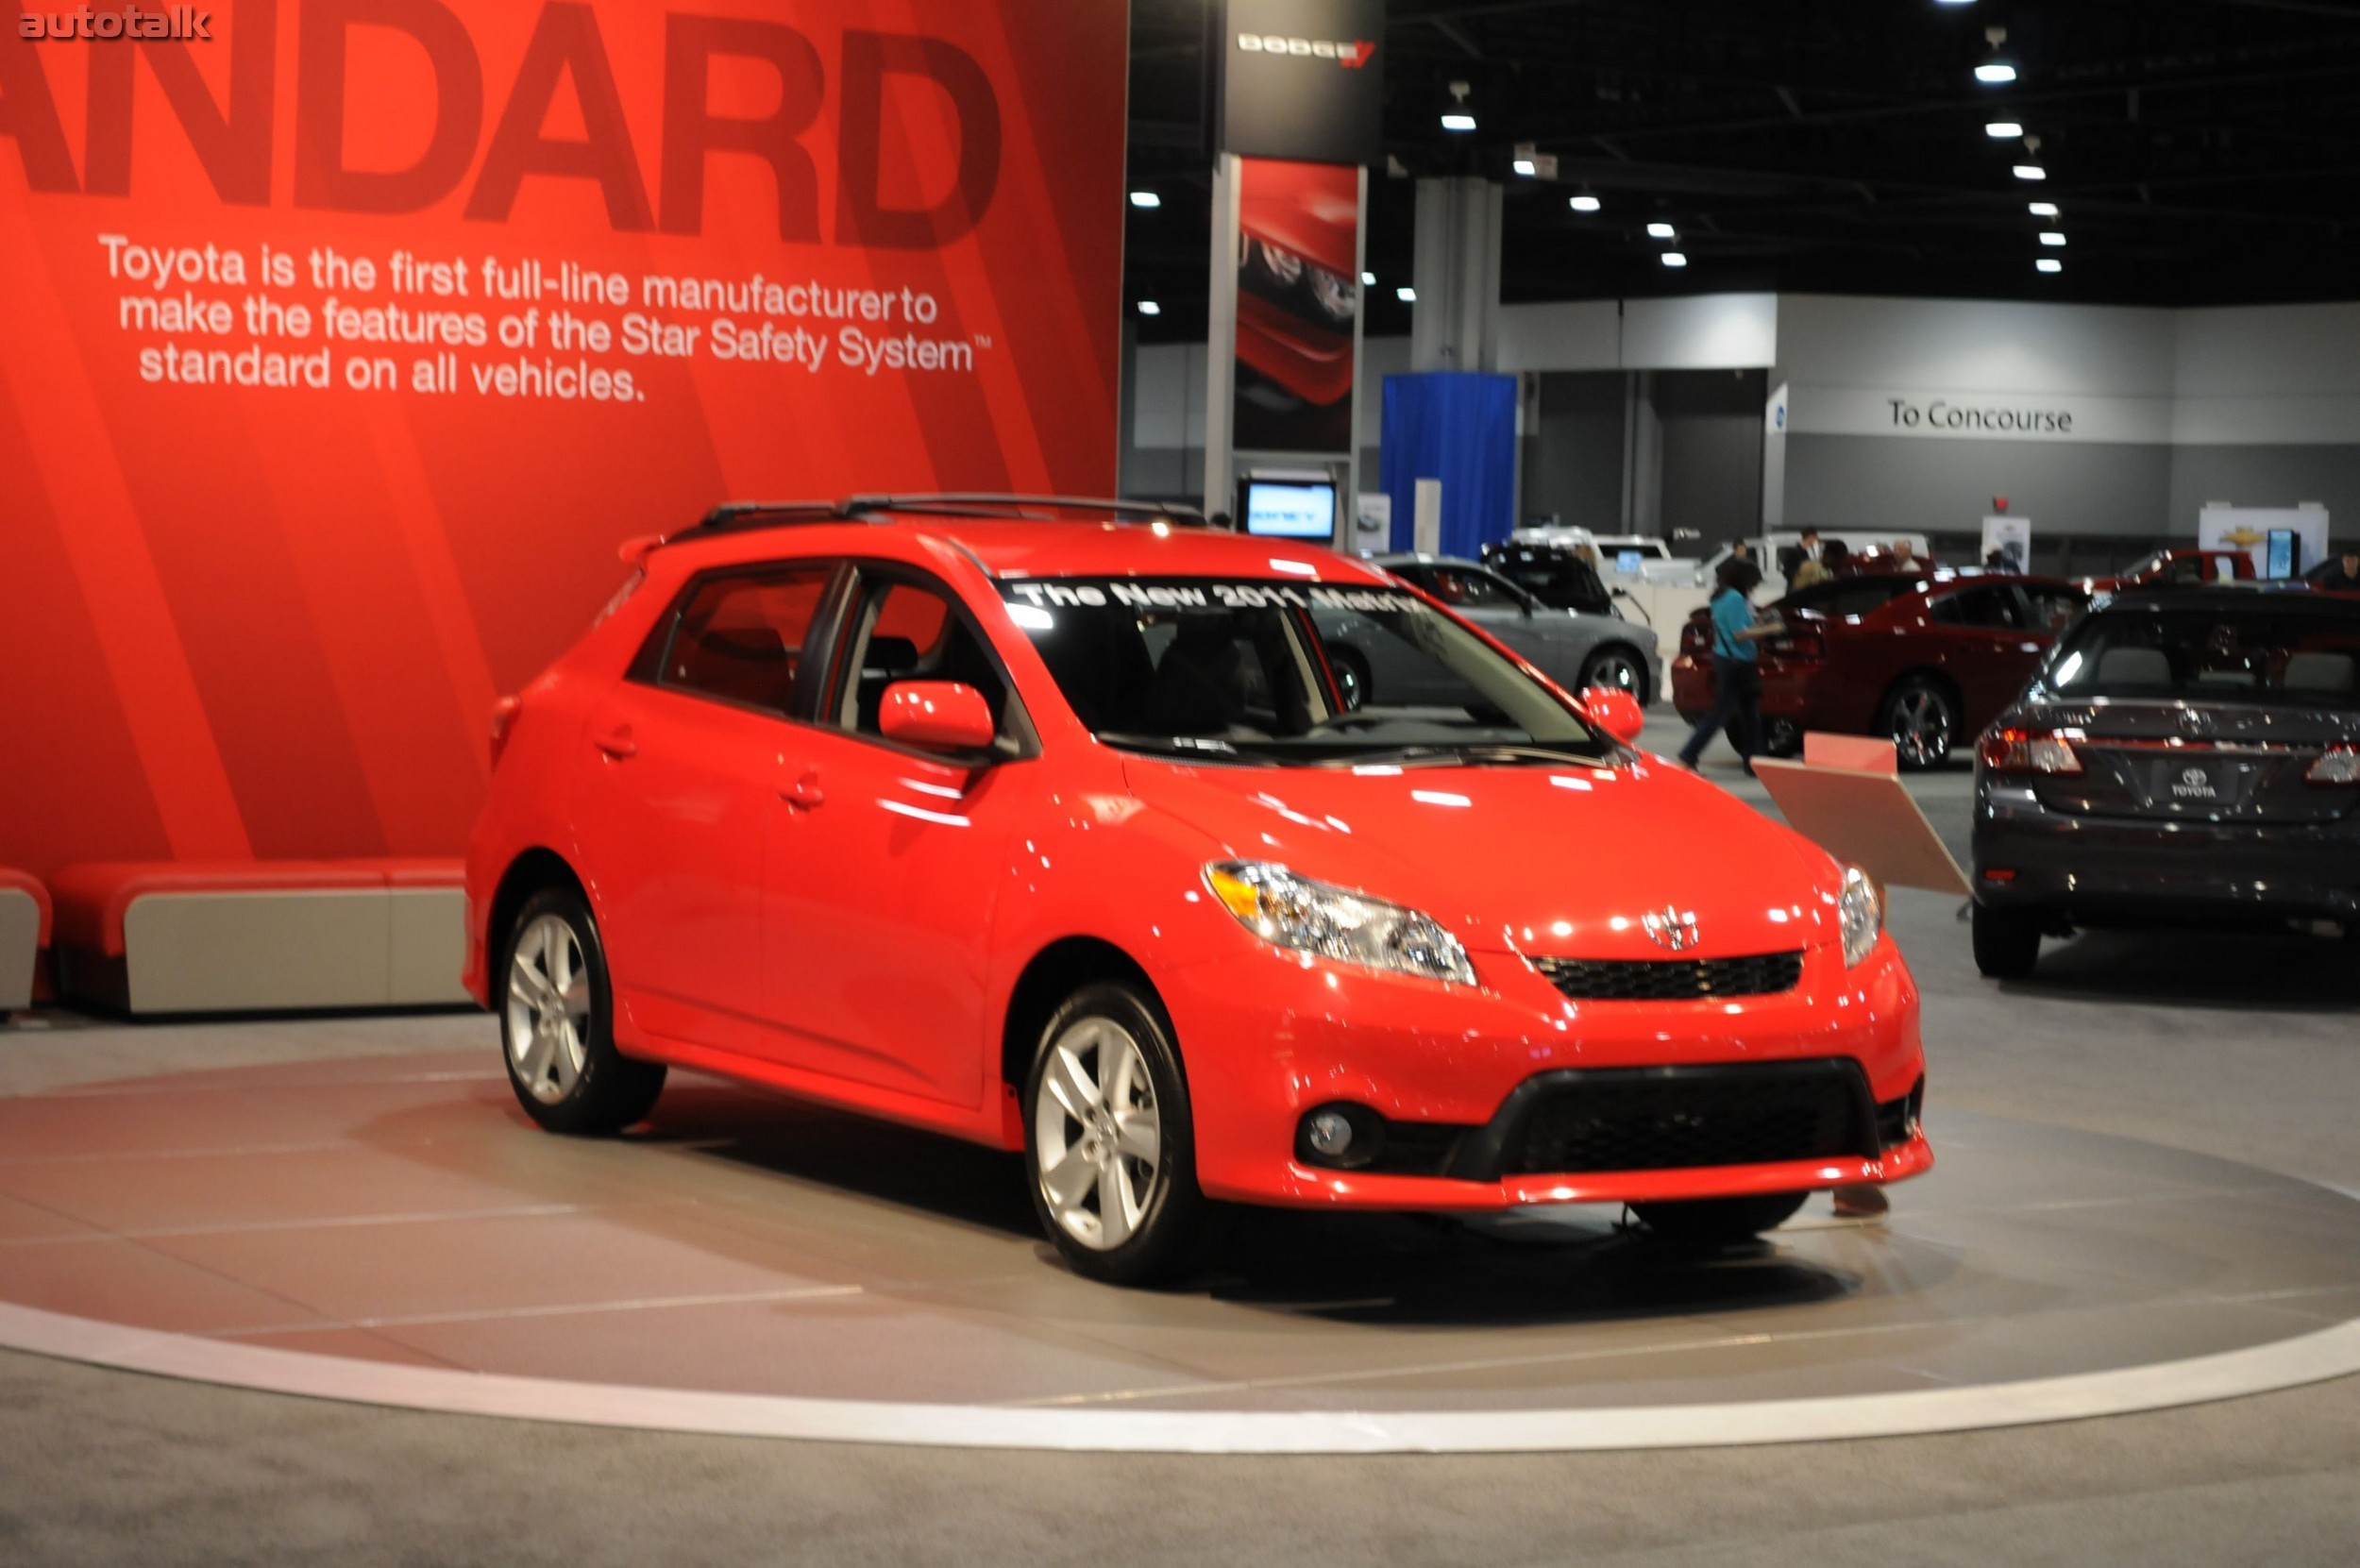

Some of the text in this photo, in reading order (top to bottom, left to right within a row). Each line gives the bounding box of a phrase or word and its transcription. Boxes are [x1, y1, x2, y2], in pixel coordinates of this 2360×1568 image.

[1238, 32, 1359, 59] DODGE
[98, 233, 938, 325] Toyota is the first full-line manufacturer to
[119, 290, 234, 335] make
[243, 293, 312, 339] the
[323, 296, 488, 346] features
[497, 307, 541, 349] of
[548, 310, 612, 353] the
[620, 312, 701, 358] Star
[710, 318, 828, 374] Safety
[139, 343, 646, 403] standard on all vehicles.
[1888, 398, 2072, 433] To Concourse
[1012, 582, 1108, 607] The
[1109, 582, 1208, 607] New
[1212, 584, 1307, 609] 2011
[2172, 784, 2217, 799] TOYOTA
